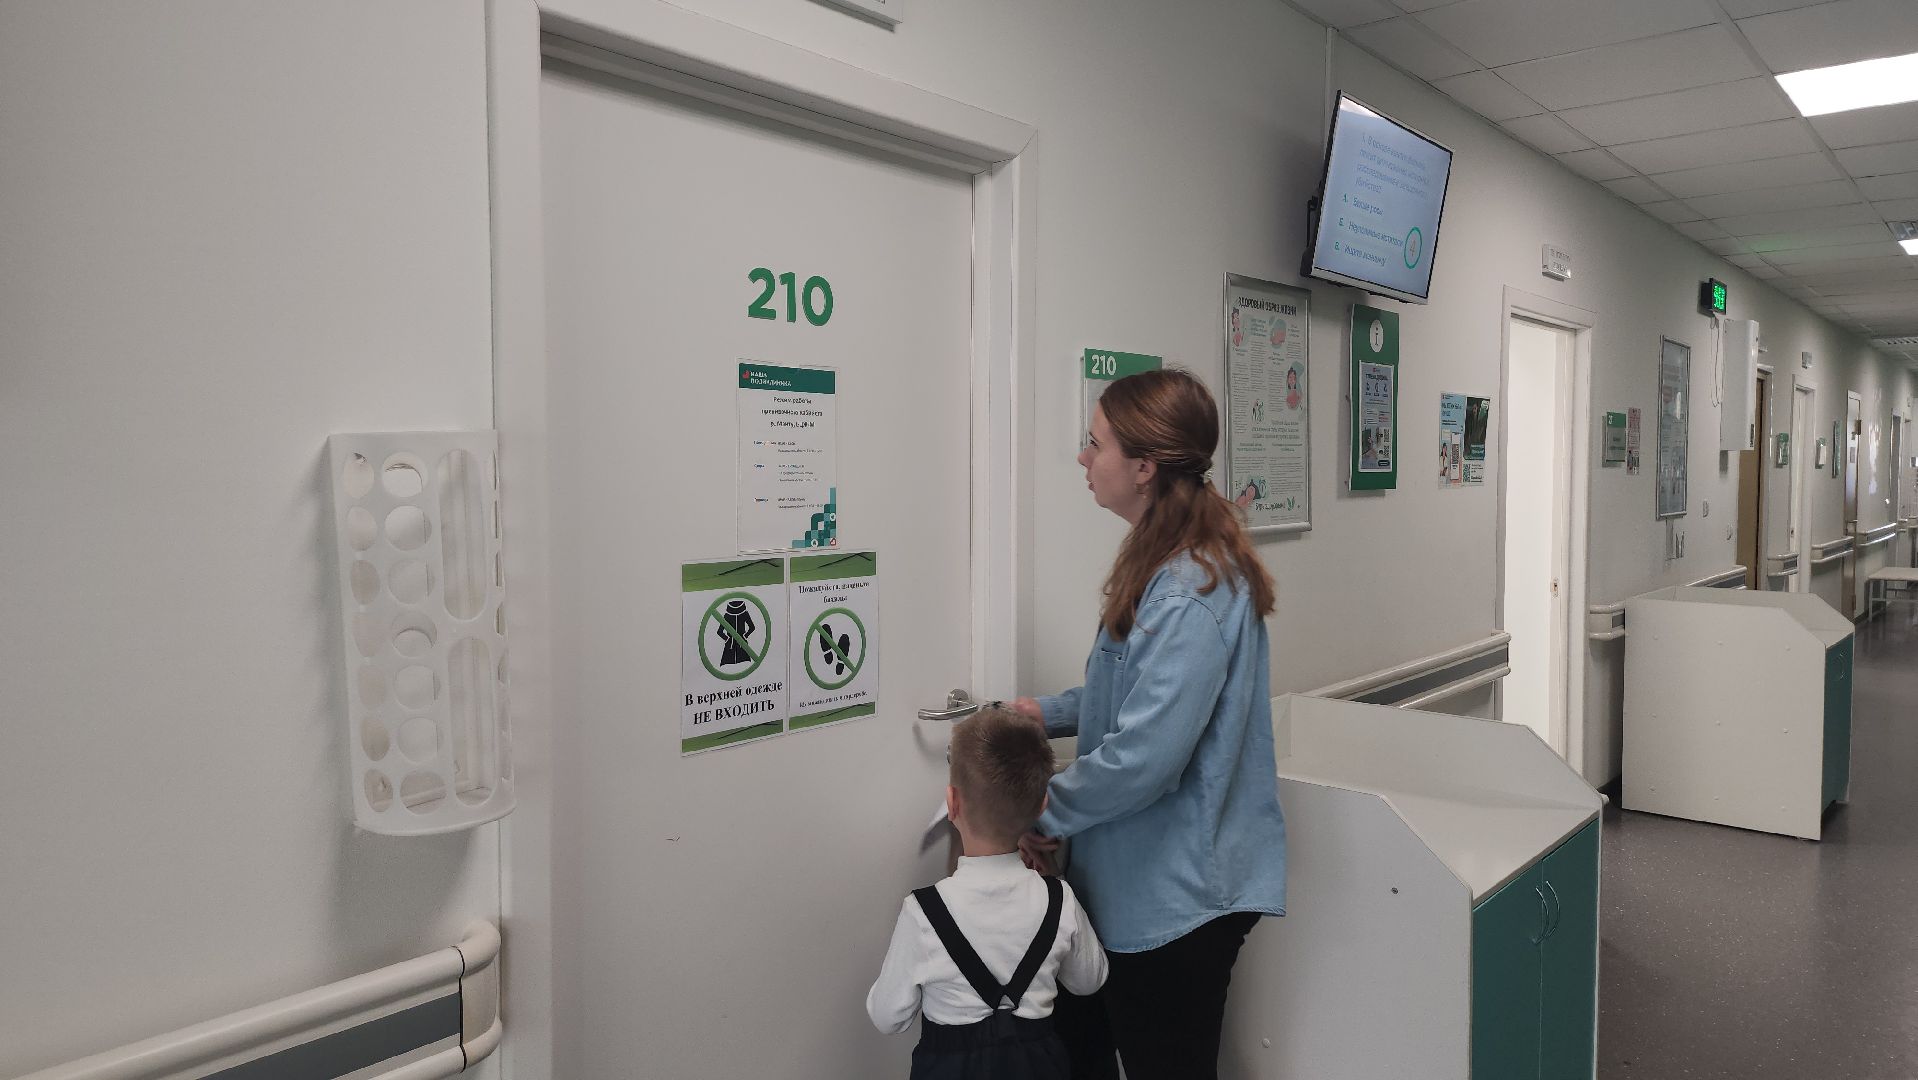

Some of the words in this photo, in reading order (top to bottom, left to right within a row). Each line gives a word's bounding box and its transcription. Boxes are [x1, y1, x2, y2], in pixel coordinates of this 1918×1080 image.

[747, 267, 834, 326] 210
[1091, 354, 1117, 376] 210
[685, 694, 694, 706] В
[697, 687, 742, 705] верхней
[745, 680, 783, 697] одежде
[693, 709, 712, 725] НЕ
[714, 699, 775, 721] ВХОДИТЬ
